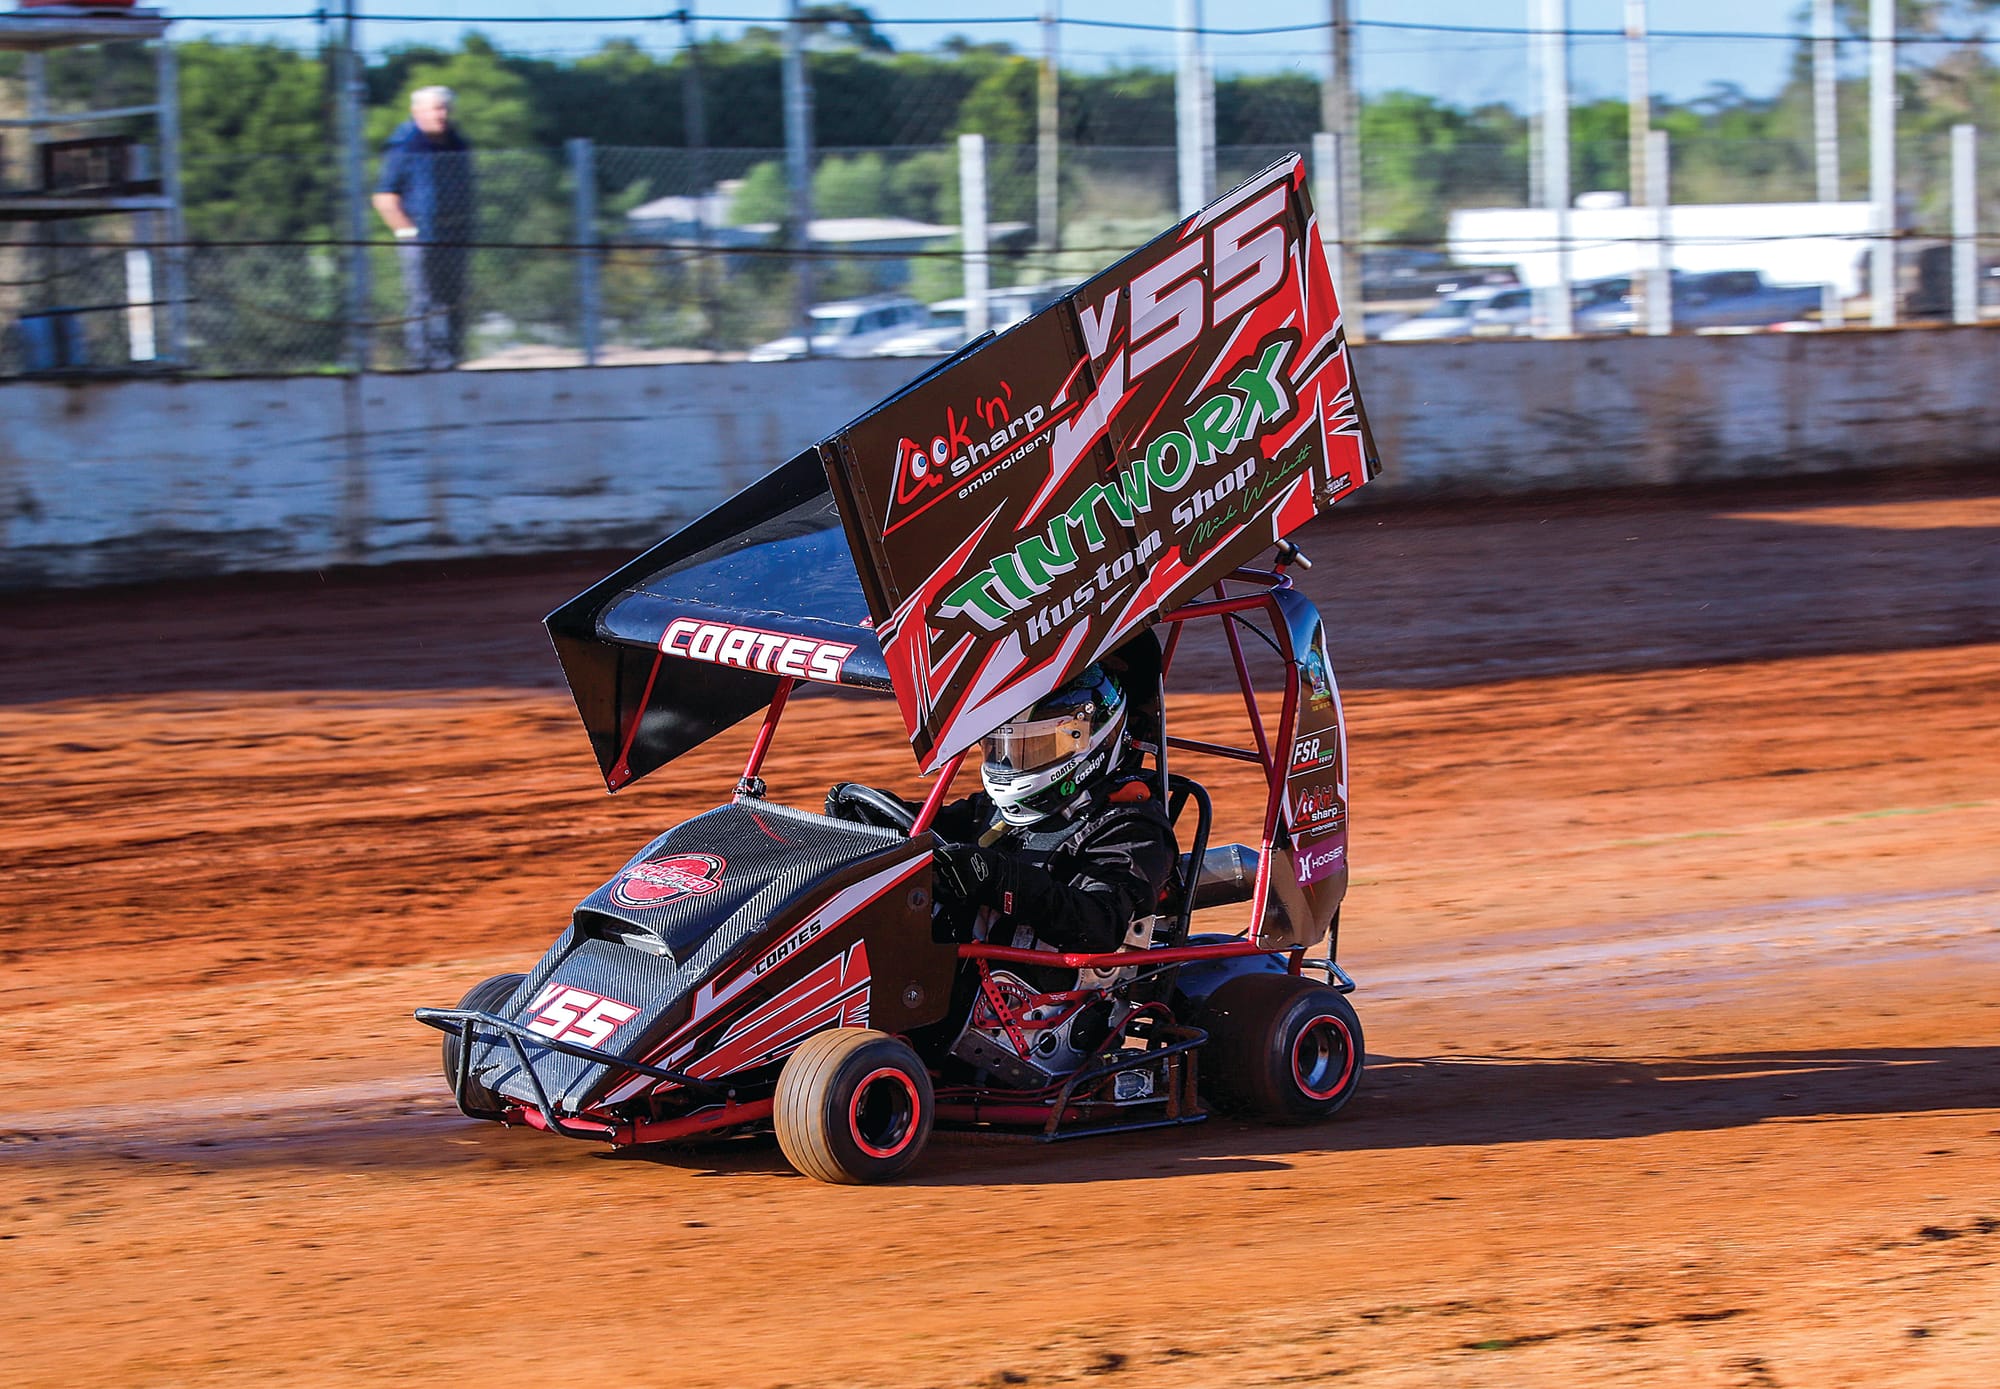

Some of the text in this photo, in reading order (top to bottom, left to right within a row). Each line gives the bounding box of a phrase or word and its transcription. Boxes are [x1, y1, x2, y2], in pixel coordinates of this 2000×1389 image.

[1079, 183, 1288, 382] V55
[949, 404, 1045, 478] sharp
[957, 429, 1052, 500] embroidery
[936, 339, 1294, 633] TINTWORX
[1025, 456, 1258, 646] Kustom Shop
[658, 616, 858, 683] COATES
[1050, 758, 1080, 783] COATES
[1292, 737, 1321, 766] FSR
[1311, 806, 1338, 822] sharp
[1311, 845, 1344, 869] HOOSIER
[755, 919, 822, 976] COATES
[526, 982, 642, 1051] V55
